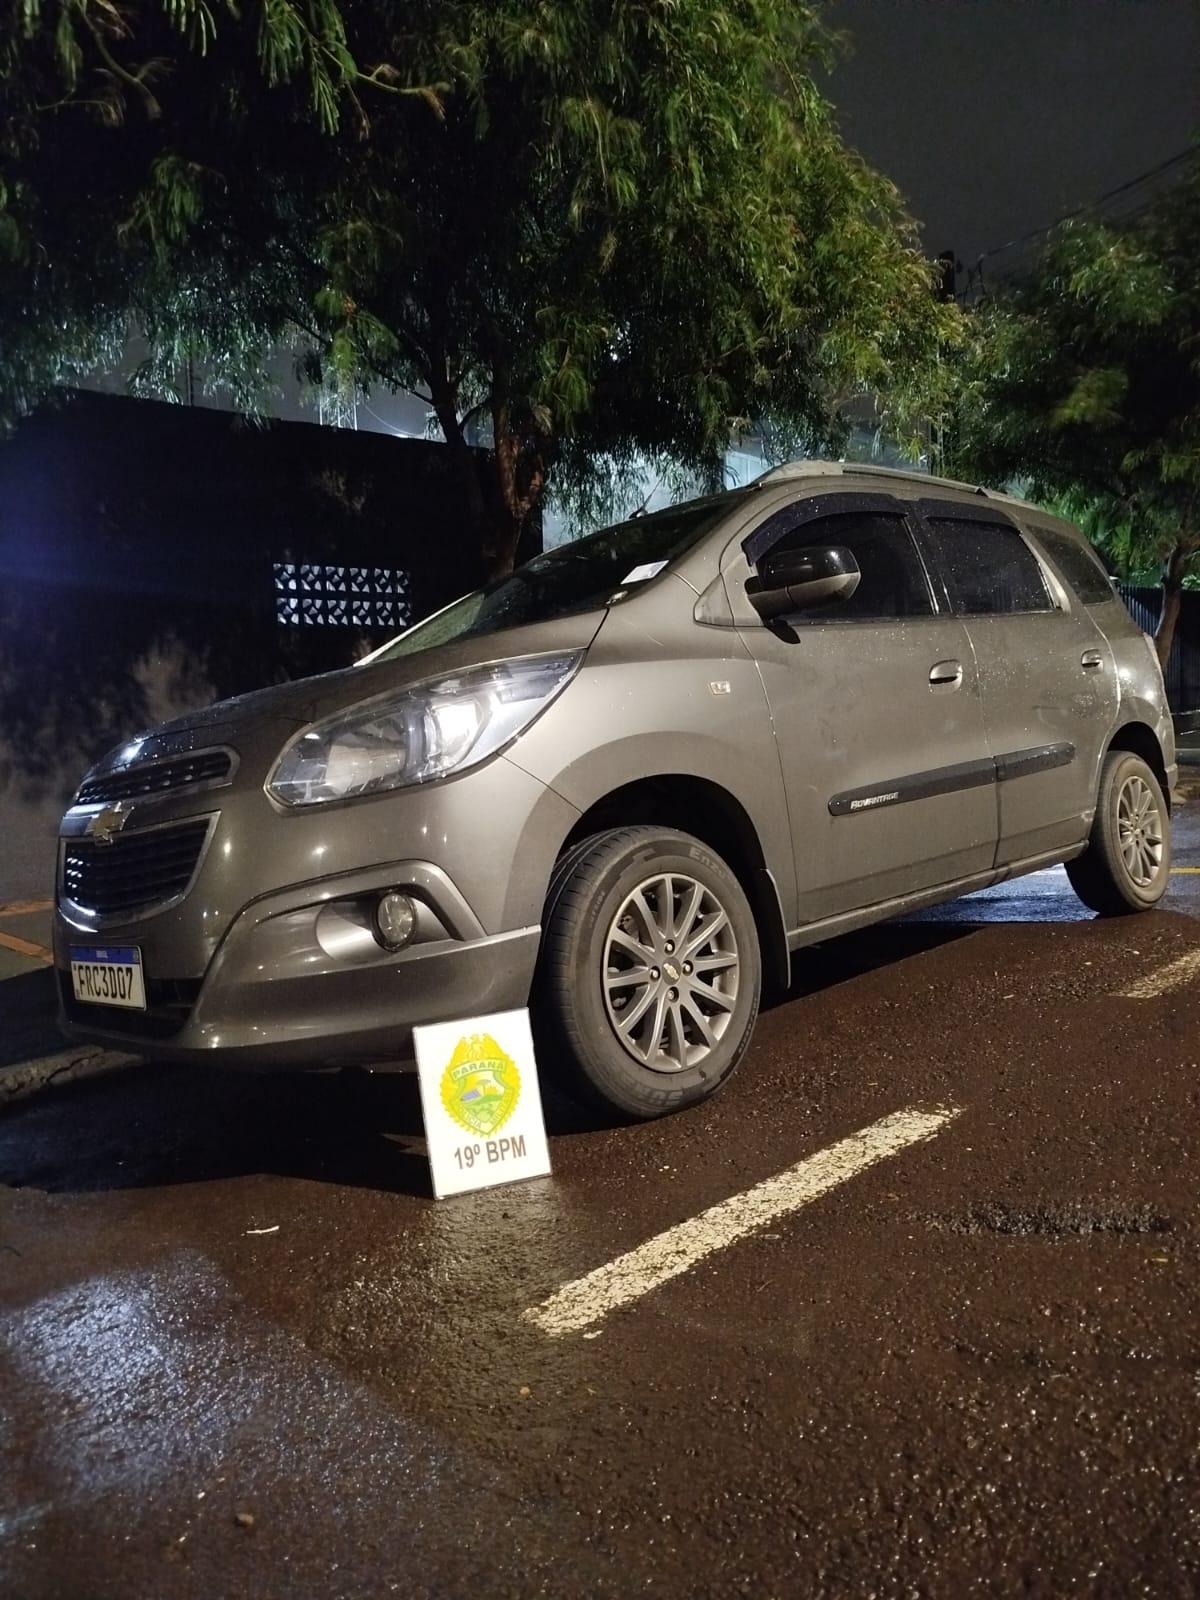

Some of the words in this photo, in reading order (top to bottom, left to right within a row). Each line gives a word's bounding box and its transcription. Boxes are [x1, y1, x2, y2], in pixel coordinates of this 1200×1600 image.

[850, 791, 899, 810] ADVANTAGE
[78, 965, 133, 1000] FRC3D07
[485, 1134, 527, 1163] BPM
